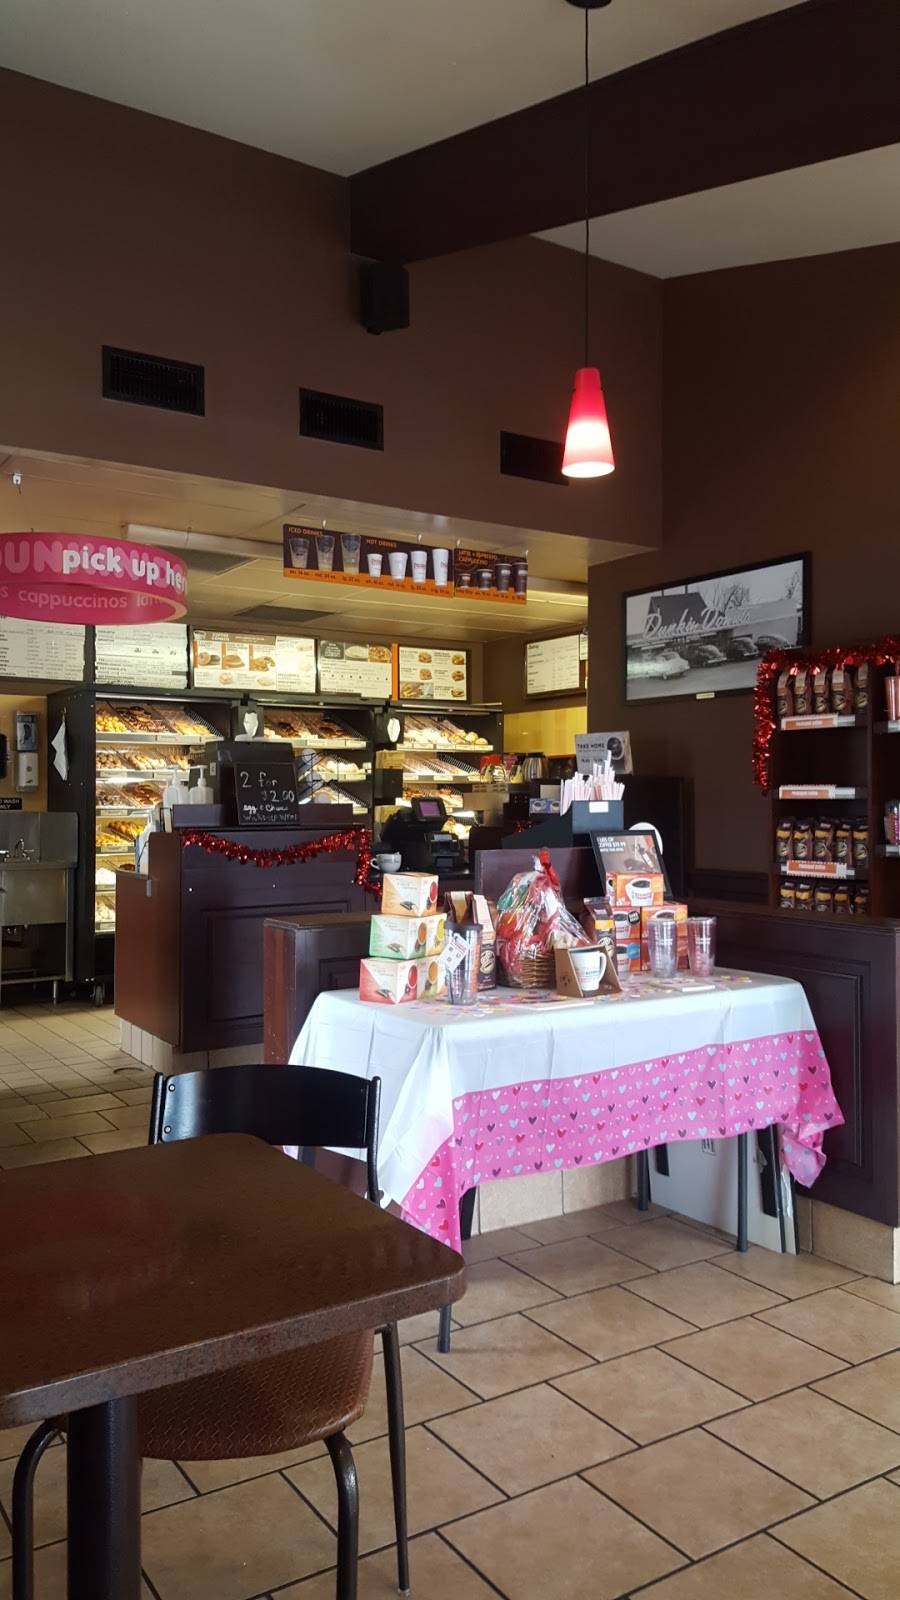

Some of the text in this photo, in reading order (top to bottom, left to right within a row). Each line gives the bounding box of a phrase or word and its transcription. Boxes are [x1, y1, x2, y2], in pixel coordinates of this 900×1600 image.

[62, 545, 122, 575] pick
[131, 558, 160, 585] up
[18, 590, 127, 609] cappuccinos
[240, 771, 278, 788] 2 for
